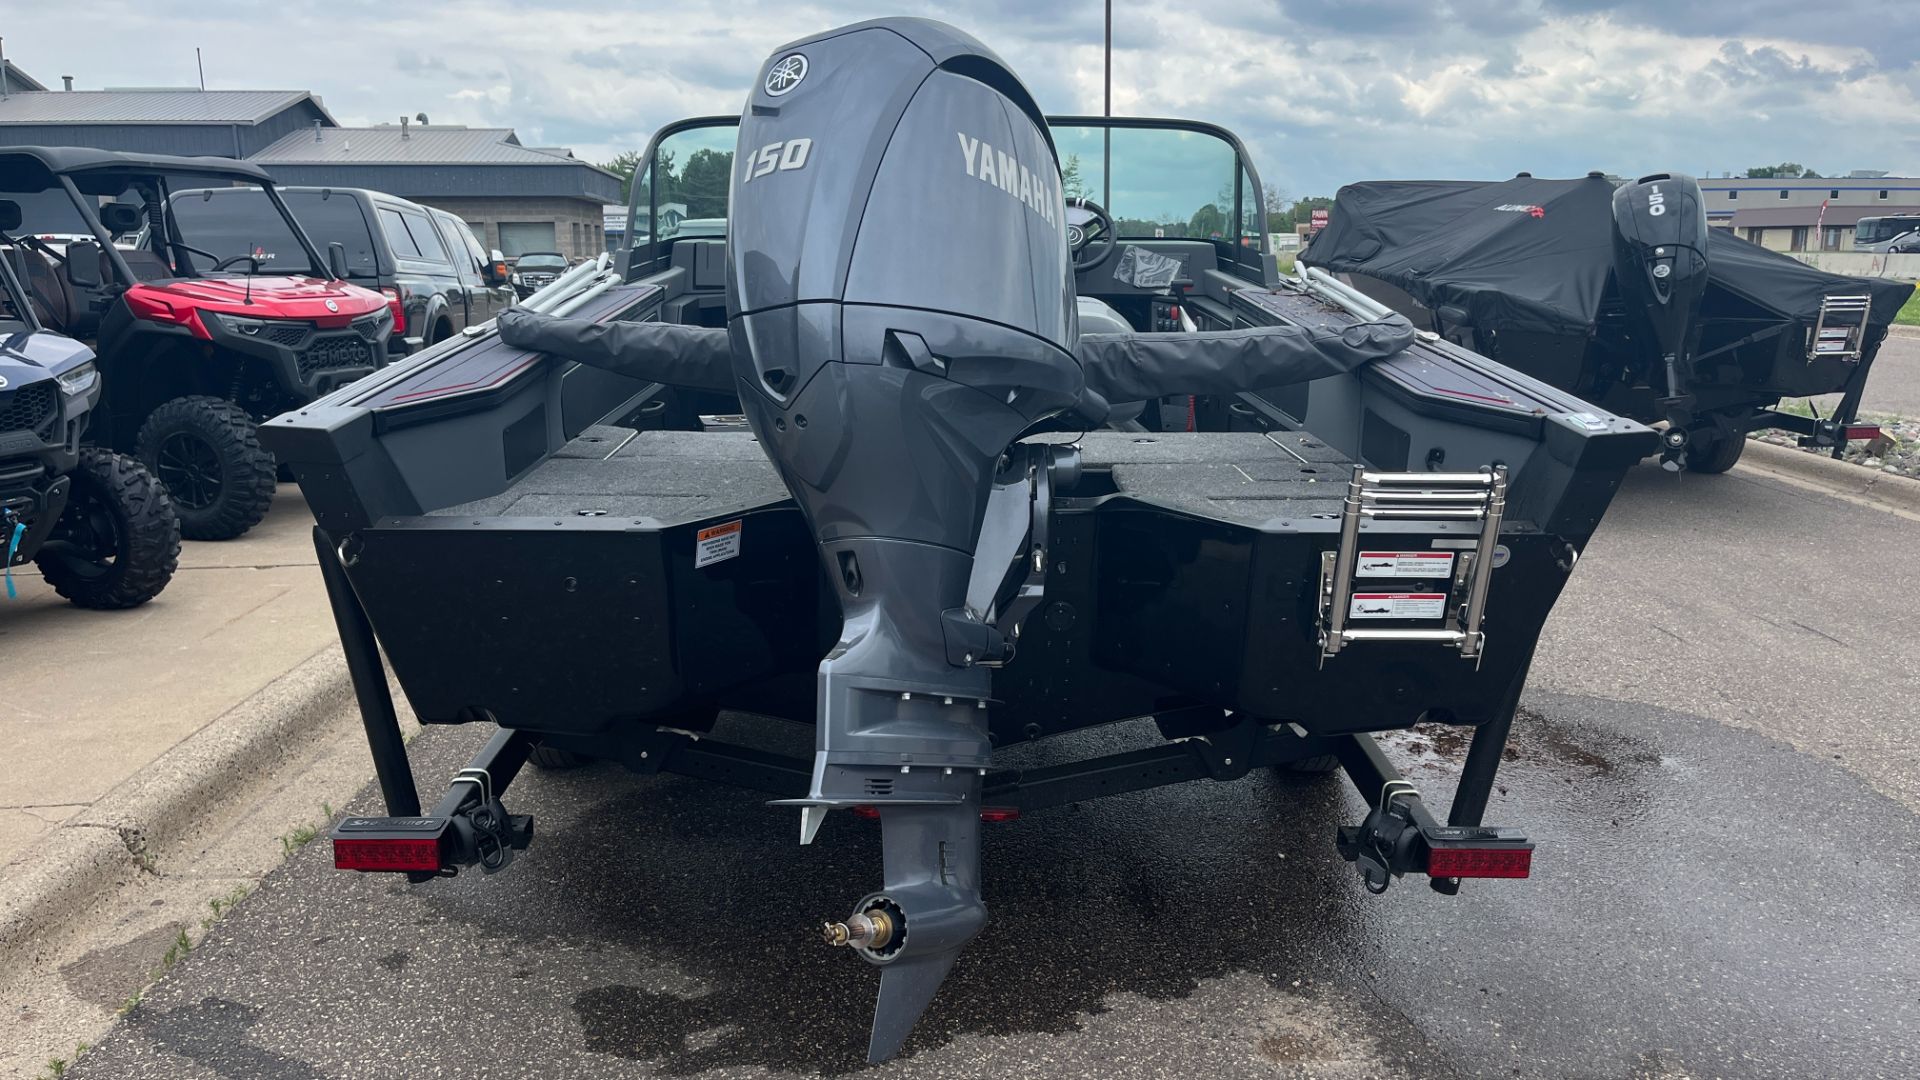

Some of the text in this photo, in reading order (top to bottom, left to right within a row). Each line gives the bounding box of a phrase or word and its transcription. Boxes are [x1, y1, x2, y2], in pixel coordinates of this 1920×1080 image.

[744, 138, 812, 183] 150
[957, 131, 1056, 230] YAMAHA
[1312, 210, 1328, 218] PAWN
[1648, 184, 1666, 216] 150
[711, 525, 736, 535] WARNING
